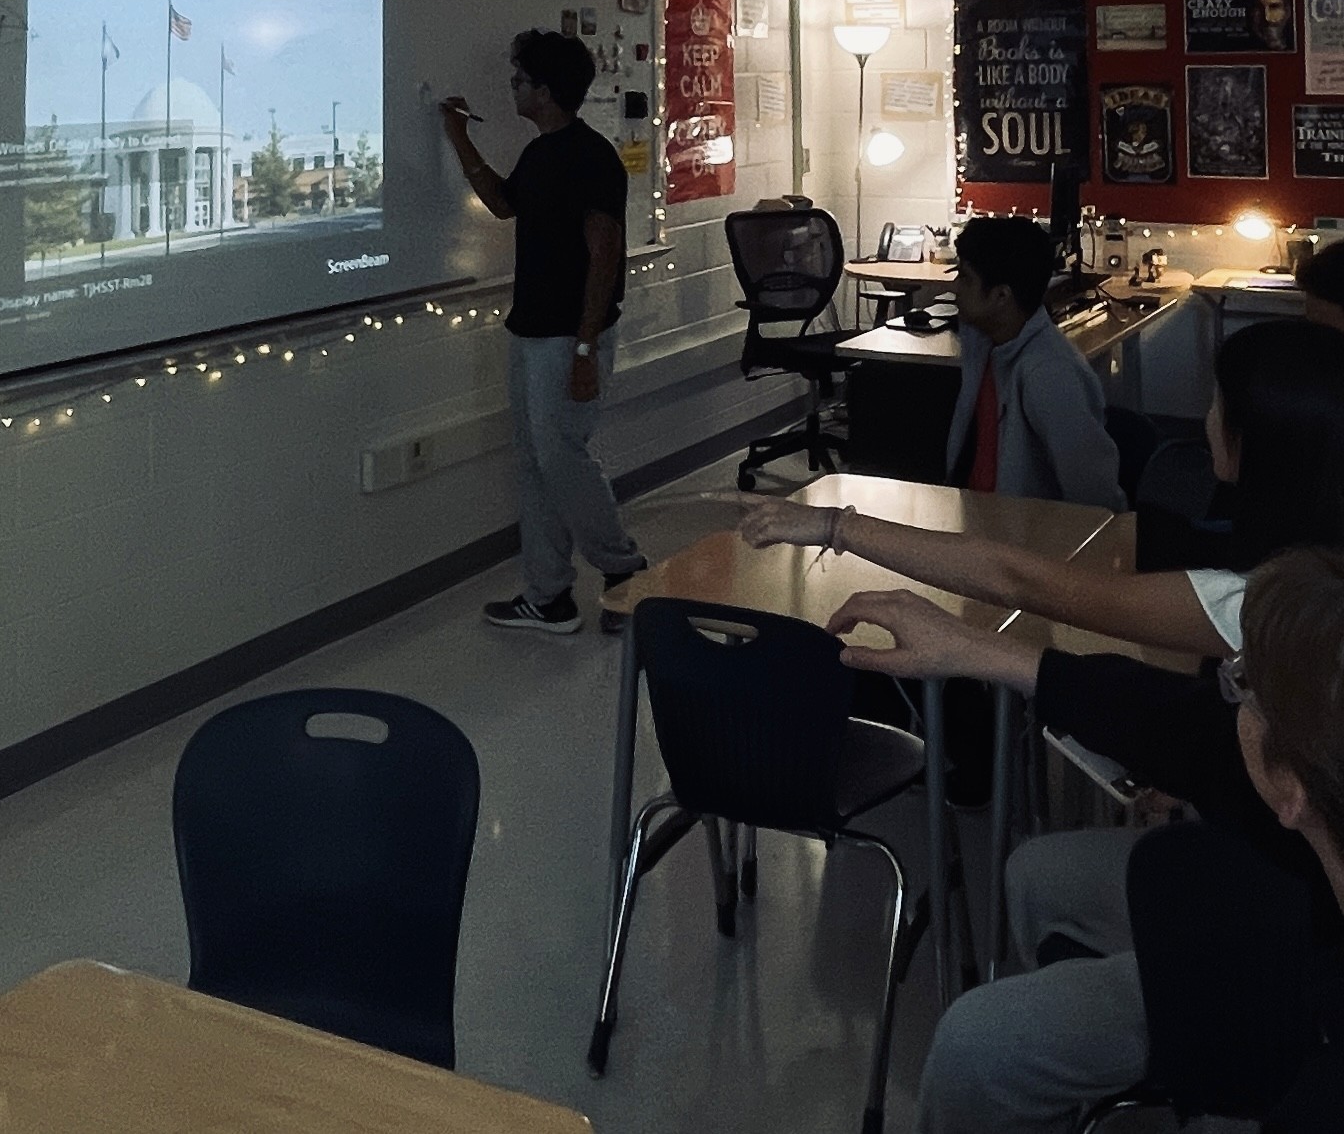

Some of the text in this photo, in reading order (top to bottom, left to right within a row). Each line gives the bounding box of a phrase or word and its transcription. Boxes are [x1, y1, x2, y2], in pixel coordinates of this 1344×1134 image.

[1192, 7, 1246, 19] ENOUGH
[682, 43, 721, 67] KEEP
[977, 34, 1066, 61] Books is
[977, 63, 1070, 86] LIKE A BODY
[679, 75, 723, 98] CALM
[979, 86, 1049, 109] without
[128, 135, 140, 147] to
[981, 110, 1072, 156] SOUL
[327, 254, 390, 275] ScreenBeam
